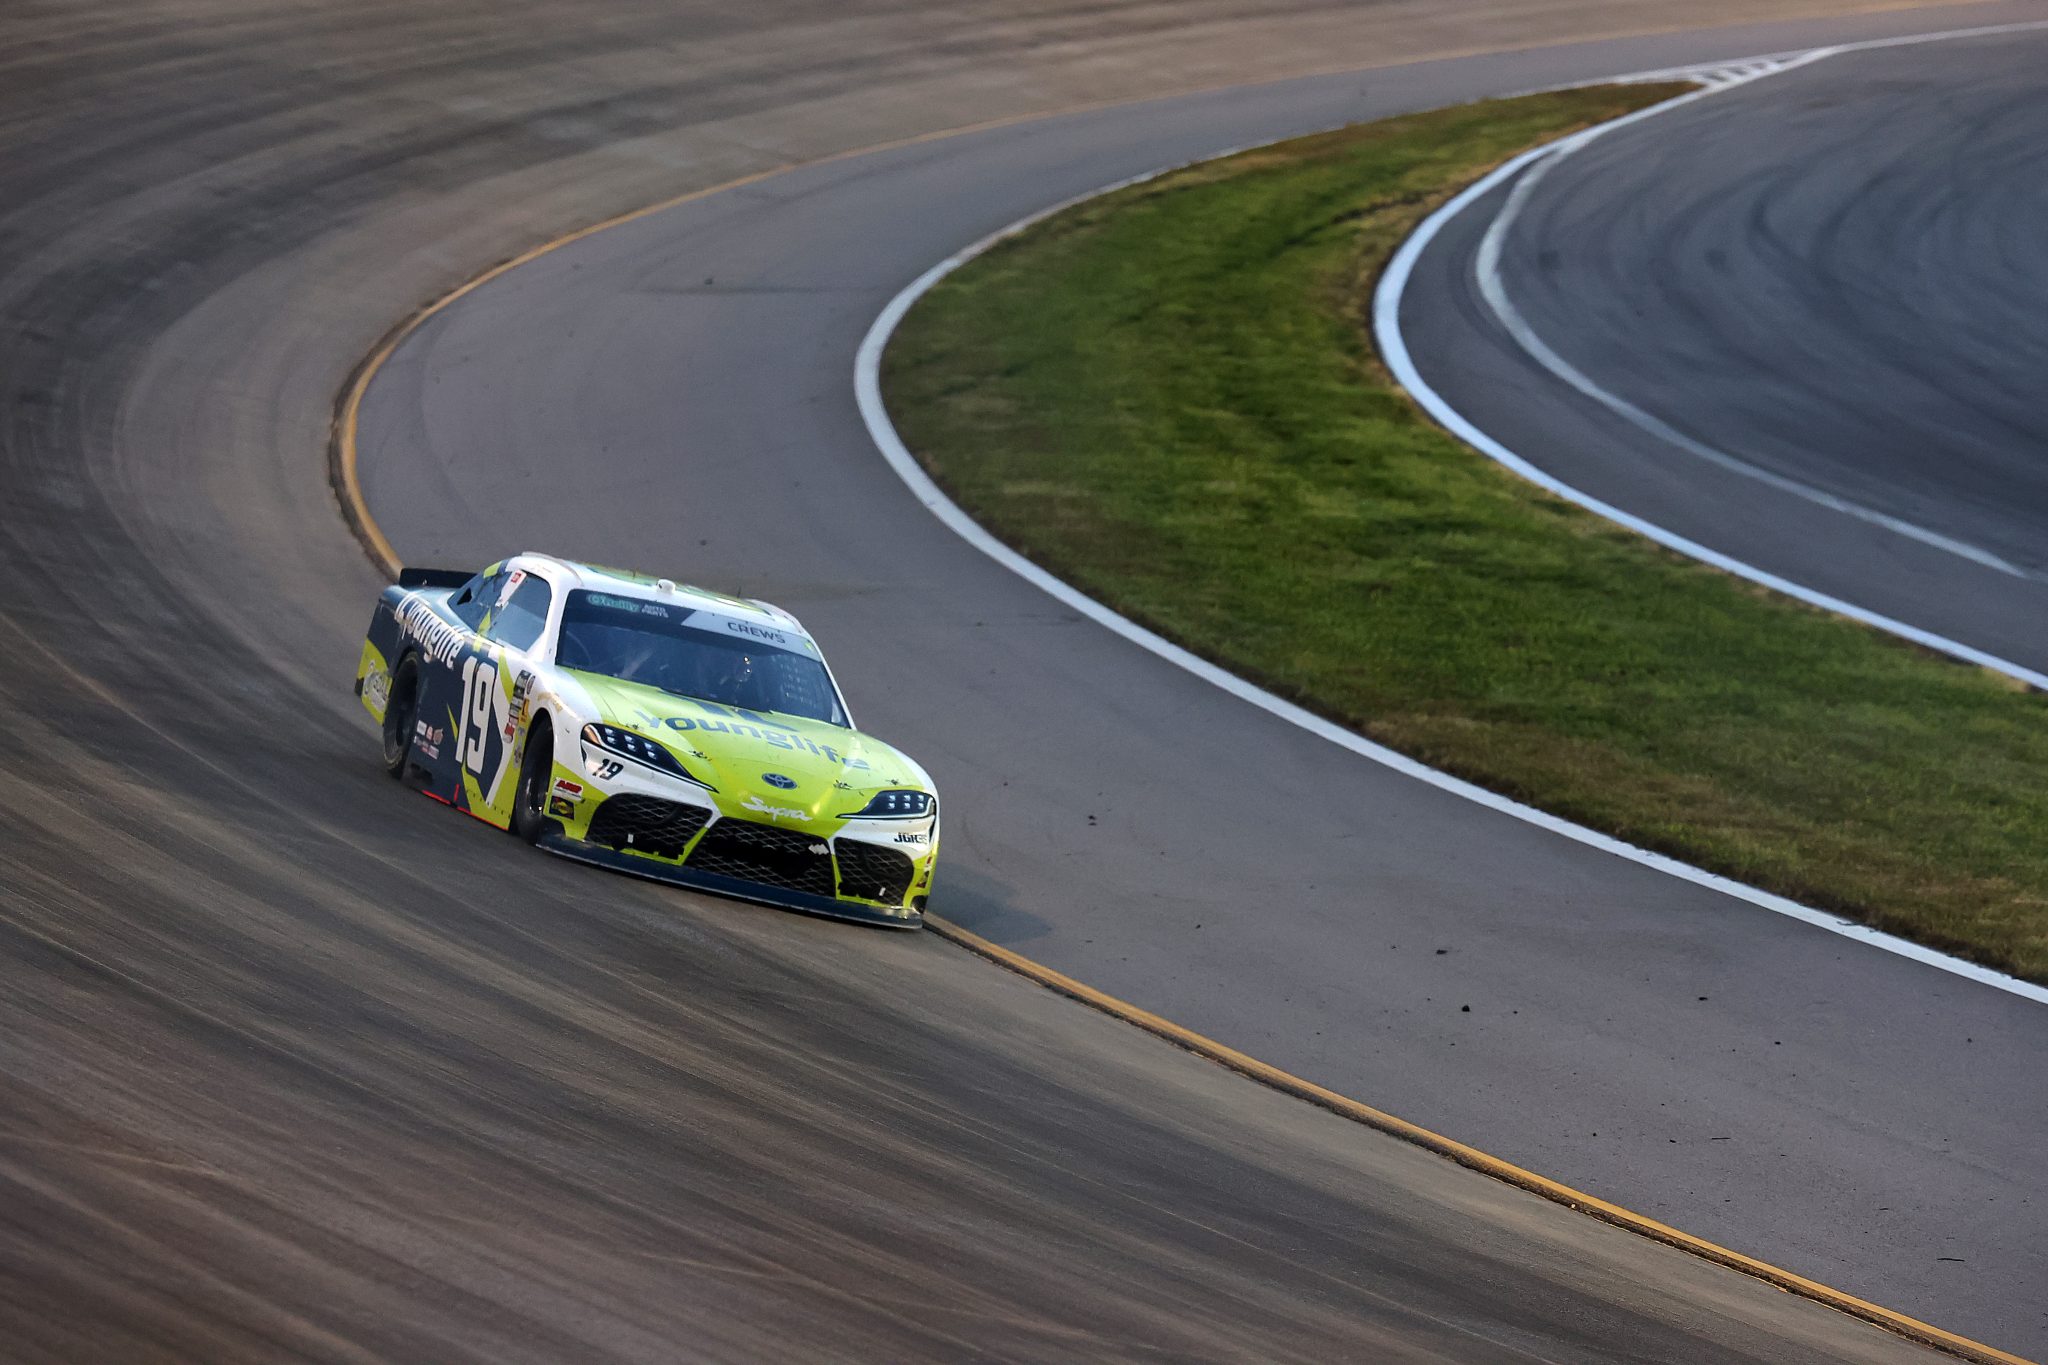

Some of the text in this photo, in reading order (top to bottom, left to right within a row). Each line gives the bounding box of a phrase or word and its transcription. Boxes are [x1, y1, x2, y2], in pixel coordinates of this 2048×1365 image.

[727, 621, 786, 643] CREWS
[455, 655, 495, 774] 19
[635, 708, 870, 770] younglife
[592, 758, 624, 780] 19
[741, 797, 813, 822] Supra
